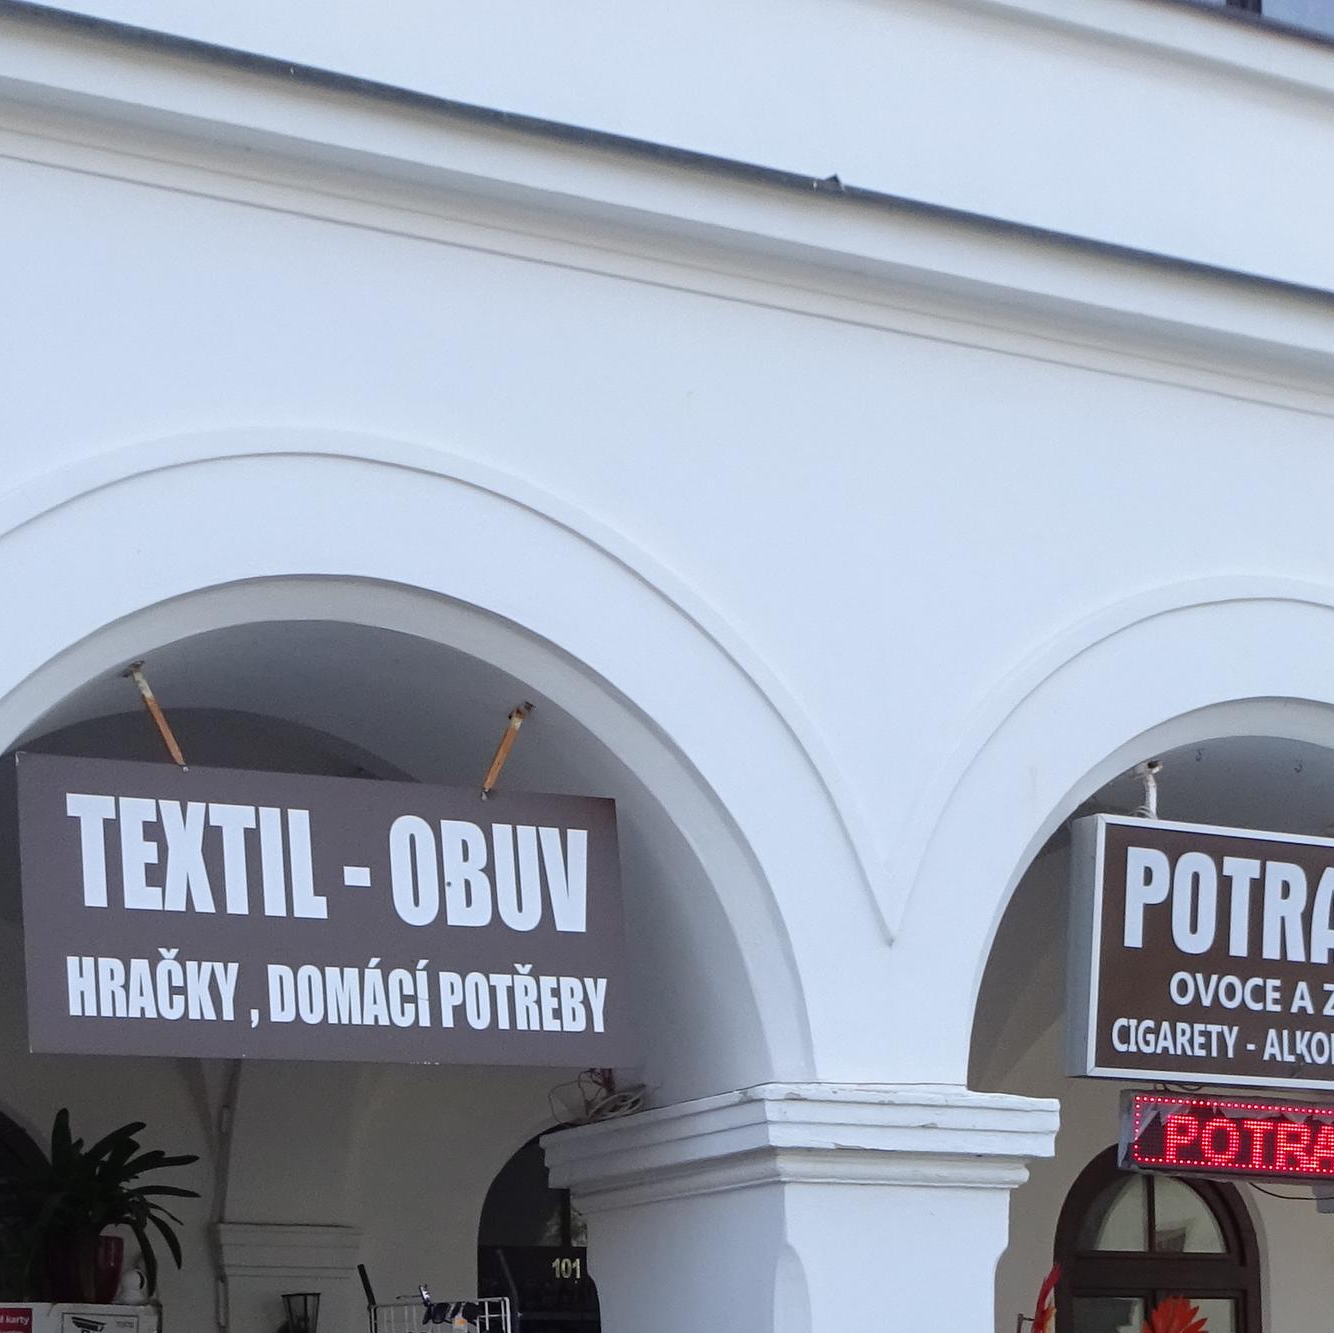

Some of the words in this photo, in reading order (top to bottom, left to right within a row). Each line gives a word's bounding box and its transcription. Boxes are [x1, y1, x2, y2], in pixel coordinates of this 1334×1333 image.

[67, 793, 328, 919] TEXTIL
[388, 814, 588, 932] OBUV
[67, 947, 239, 1020] HRAČKY
[439, 963, 607, 1033] POTŘEBY
[1170, 971, 1282, 1013] OVOCE
[1292, 981, 1314, 1015] A
[1112, 1018, 1239, 1059] CIGARETY
[552, 1258, 581, 1279] 101
